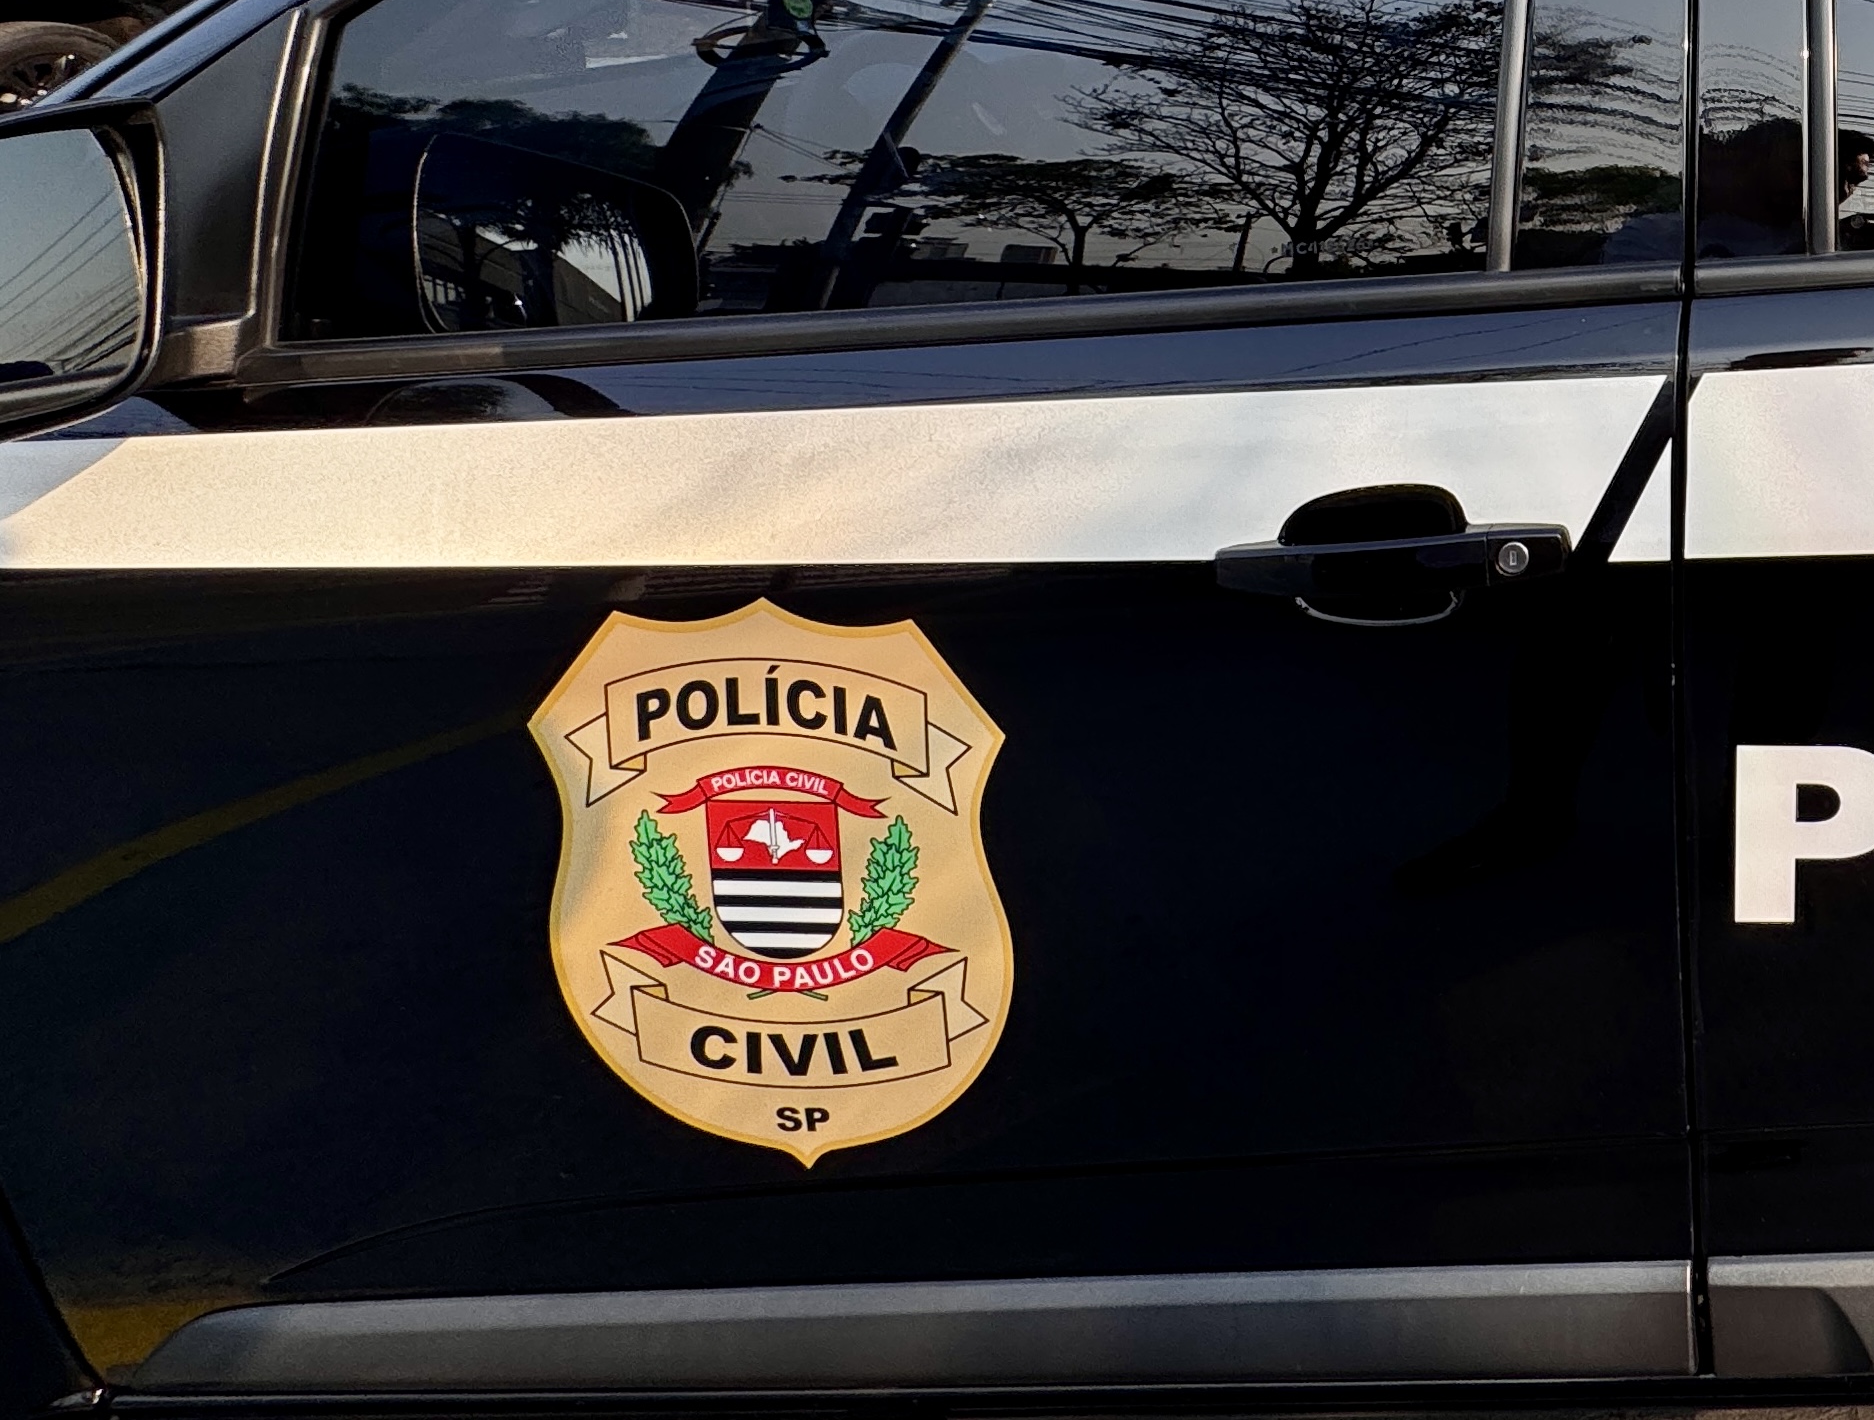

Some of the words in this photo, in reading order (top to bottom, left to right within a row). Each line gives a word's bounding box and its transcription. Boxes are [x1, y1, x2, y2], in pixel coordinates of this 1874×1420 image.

[636, 665, 898, 752] POLÍCIA
[785, 771, 829, 795] CIVIL
[695, 946, 761, 984] SÃO
[773, 948, 874, 989] PAULO
[689, 1026, 898, 1076] CIVIL
[776, 1106, 831, 1132] SP
